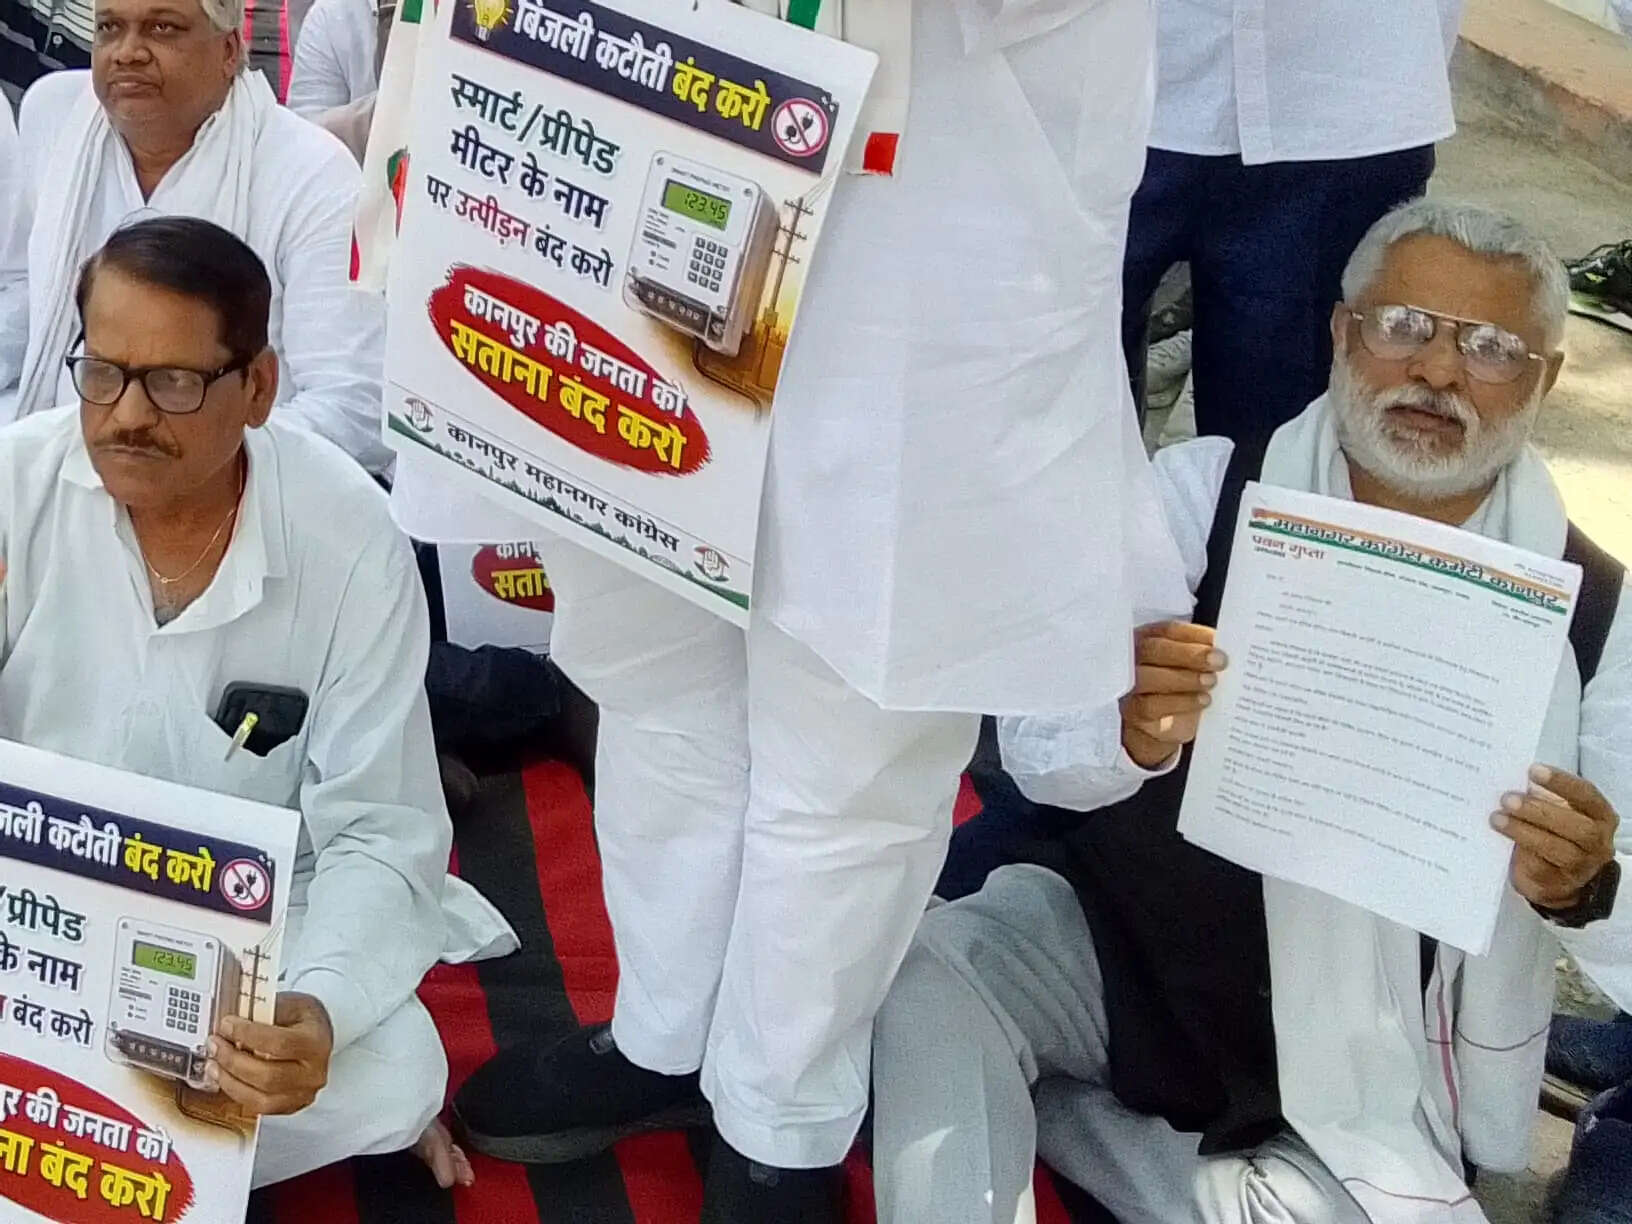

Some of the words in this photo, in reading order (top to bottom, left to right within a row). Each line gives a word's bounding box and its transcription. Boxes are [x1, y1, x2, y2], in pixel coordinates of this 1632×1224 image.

[595, 29, 673, 92] कटौती
[671, 56, 716, 114] बंद
[715, 79, 770, 131] करो
[451, 125, 514, 178] मीटर
[520, 153, 548, 199] के
[554, 179, 609, 229] नाम
[427, 175, 451, 210] पर
[455, 188, 530, 247] उत्पीड़न
[534, 223, 568, 265] बंद
[571, 249, 613, 287] करो
[450, 319, 552, 401] सताना
[559, 376, 610, 434] बंद
[617, 405, 687, 470] करो
[463, 283, 538, 351] कानपुर
[543, 320, 578, 365] की
[579, 341, 646, 400] जनता
[651, 376, 687, 418] को
[447, 421, 518, 473] कानपुर
[526, 459, 608, 516] महानगर
[614, 505, 680, 552] कांग्रेस
[48, 813, 123, 866] कटौती
[124, 832, 161, 880] बंद
[165, 845, 216, 893] करो
[13, 996, 44, 1033] बंद
[51, 1010, 93, 1044] करो
[27, 949, 81, 990] नाम
[25, 1087, 60, 1128] की
[62, 1107, 131, 1149] जनता
[137, 1127, 172, 1165] को
[40, 1139, 93, 1199] बंद
[100, 1169, 172, 1221] करो
